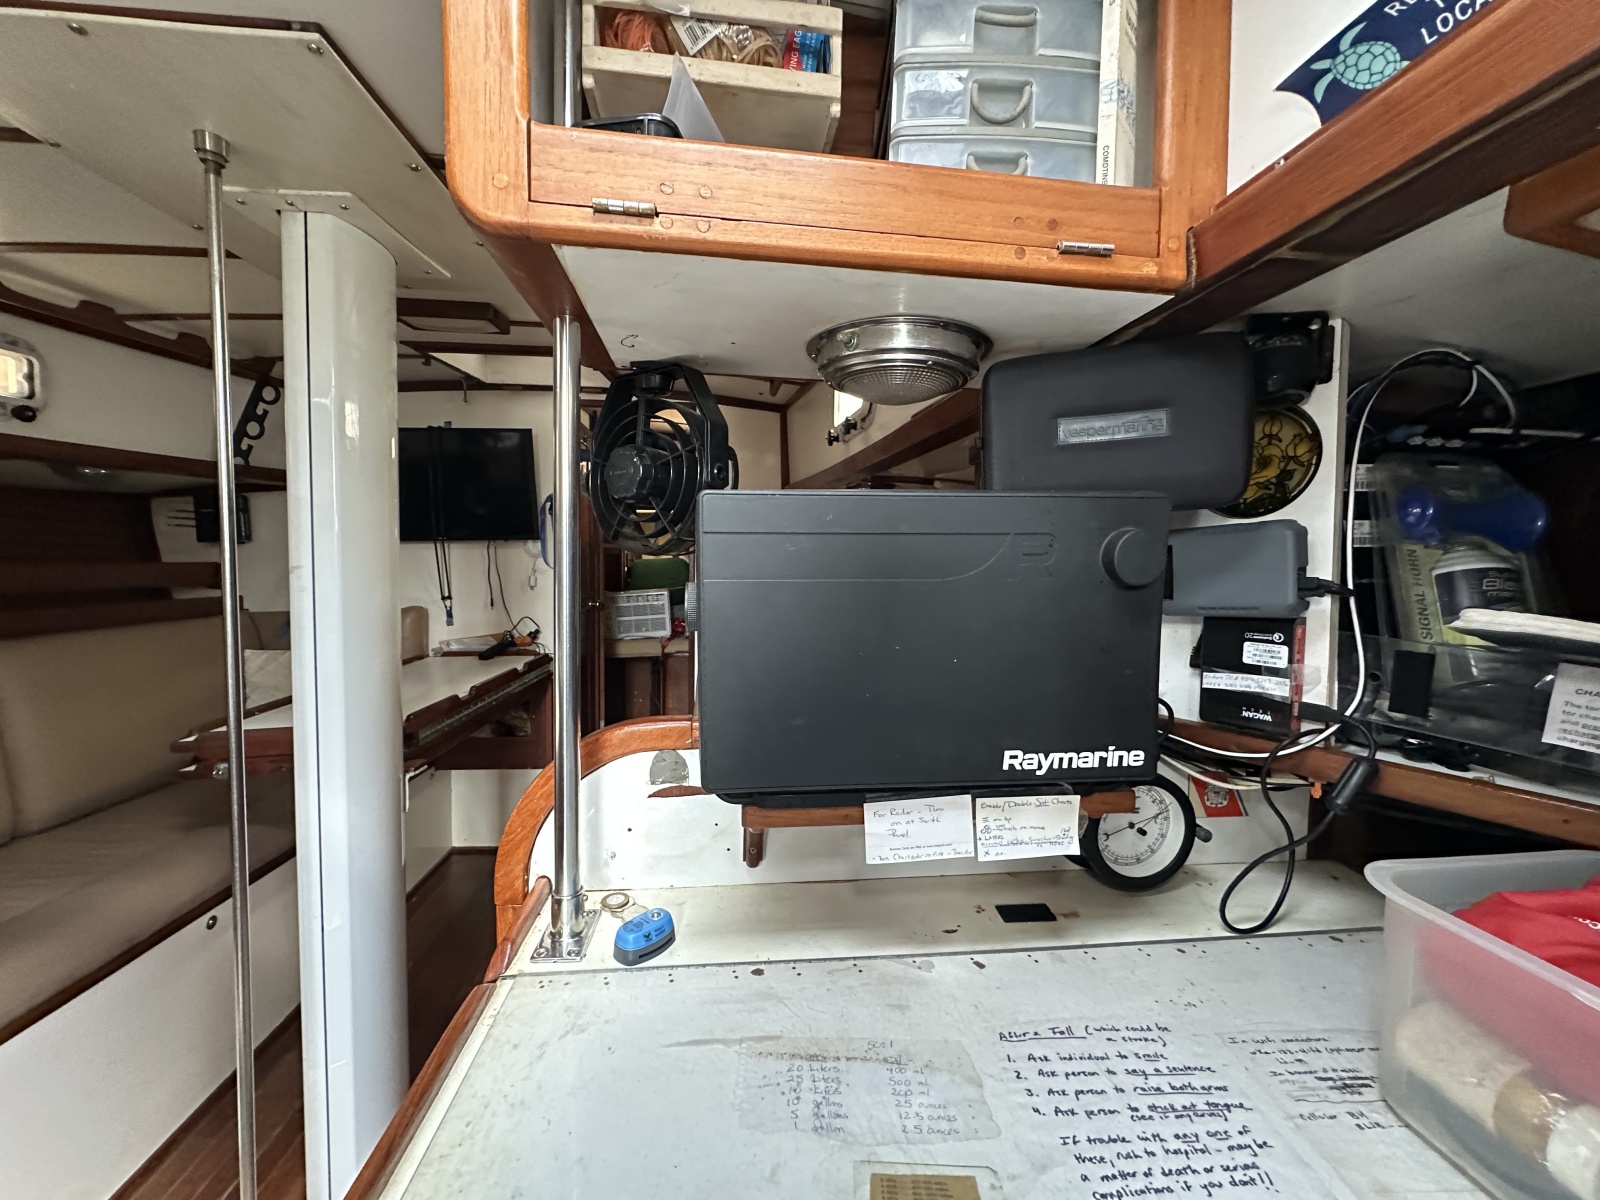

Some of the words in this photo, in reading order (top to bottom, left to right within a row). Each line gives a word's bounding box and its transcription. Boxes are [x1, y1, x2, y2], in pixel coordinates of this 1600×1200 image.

[1414, 590, 1434, 641] SIGNAL
[1242, 710, 1273, 722] WAGAN
[1002, 746, 1145, 776] Raymarine
[1047, 1024, 1076, 1037] Fall
[1125, 1024, 1153, 1033] could
[1155, 1022, 1172, 1033] be
[1027, 1052, 1052, 1063] Ask
[1056, 1051, 1111, 1062] individual
[1115, 1050, 1129, 1061] to
[1133, 1051, 1168, 1062] smile
[786, 1063, 804, 1073] 20
[886, 1066, 907, 1075] 400
[1037, 1068, 1060, 1079] Ask
[1064, 1069, 1100, 1081] person
[1105, 1067, 1118, 1076] to
[1124, 1068, 1150, 1081] say
[1166, 1064, 1217, 1075] sentence
[786, 1074, 804, 1084] 25
[888, 1076, 912, 1088] 500
[1047, 1087, 1069, 1097] Ask
[1074, 1088, 1108, 1101] person
[1113, 1085, 1126, 1095] to
[1133, 1081, 1165, 1094] raise
[1167, 1081, 1200, 1093] both
[1199, 1085, 1229, 1093] arms
[786, 1098, 801, 1107] 10
[894, 1099, 913, 1109] 25
[918, 1102, 948, 1110] ounces
[1053, 1105, 1080, 1117] Ask
[1083, 1107, 1121, 1120] person
[1126, 1102, 1140, 1113] to
[1147, 1102, 1180, 1113] stick
[1203, 1099, 1254, 1113] tongue
[790, 1108, 799, 1119] 5
[927, 1114, 958, 1123] ounces
[811, 1121, 845, 1136] gallon
[926, 1124, 961, 1136] ounces
[1059, 1133, 1082, 1147] If
[1085, 1133, 1132, 1146] trouble
[1136, 1130, 1168, 1143] with
[1173, 1131, 1200, 1144] any
[1205, 1129, 1233, 1140] one
[1237, 1124, 1252, 1136] of
[1073, 1152, 1116, 1169] these,
[1116, 1150, 1143, 1161] rush
[1143, 1147, 1158, 1158] to
[1160, 1143, 1213, 1161] hospital
[1080, 1173, 1091, 1183] a
[1099, 1169, 1139, 1183] matter
[1142, 1166, 1153, 1179] of
[1160, 1164, 1202, 1178] death
[1202, 1165, 1215, 1175] or
[1219, 1157, 1261, 1173] serious
[1092, 1181, 1175, 1200] complications
[1175, 1180, 1193, 1192] if
[1199, 1180, 1224, 1198] you
